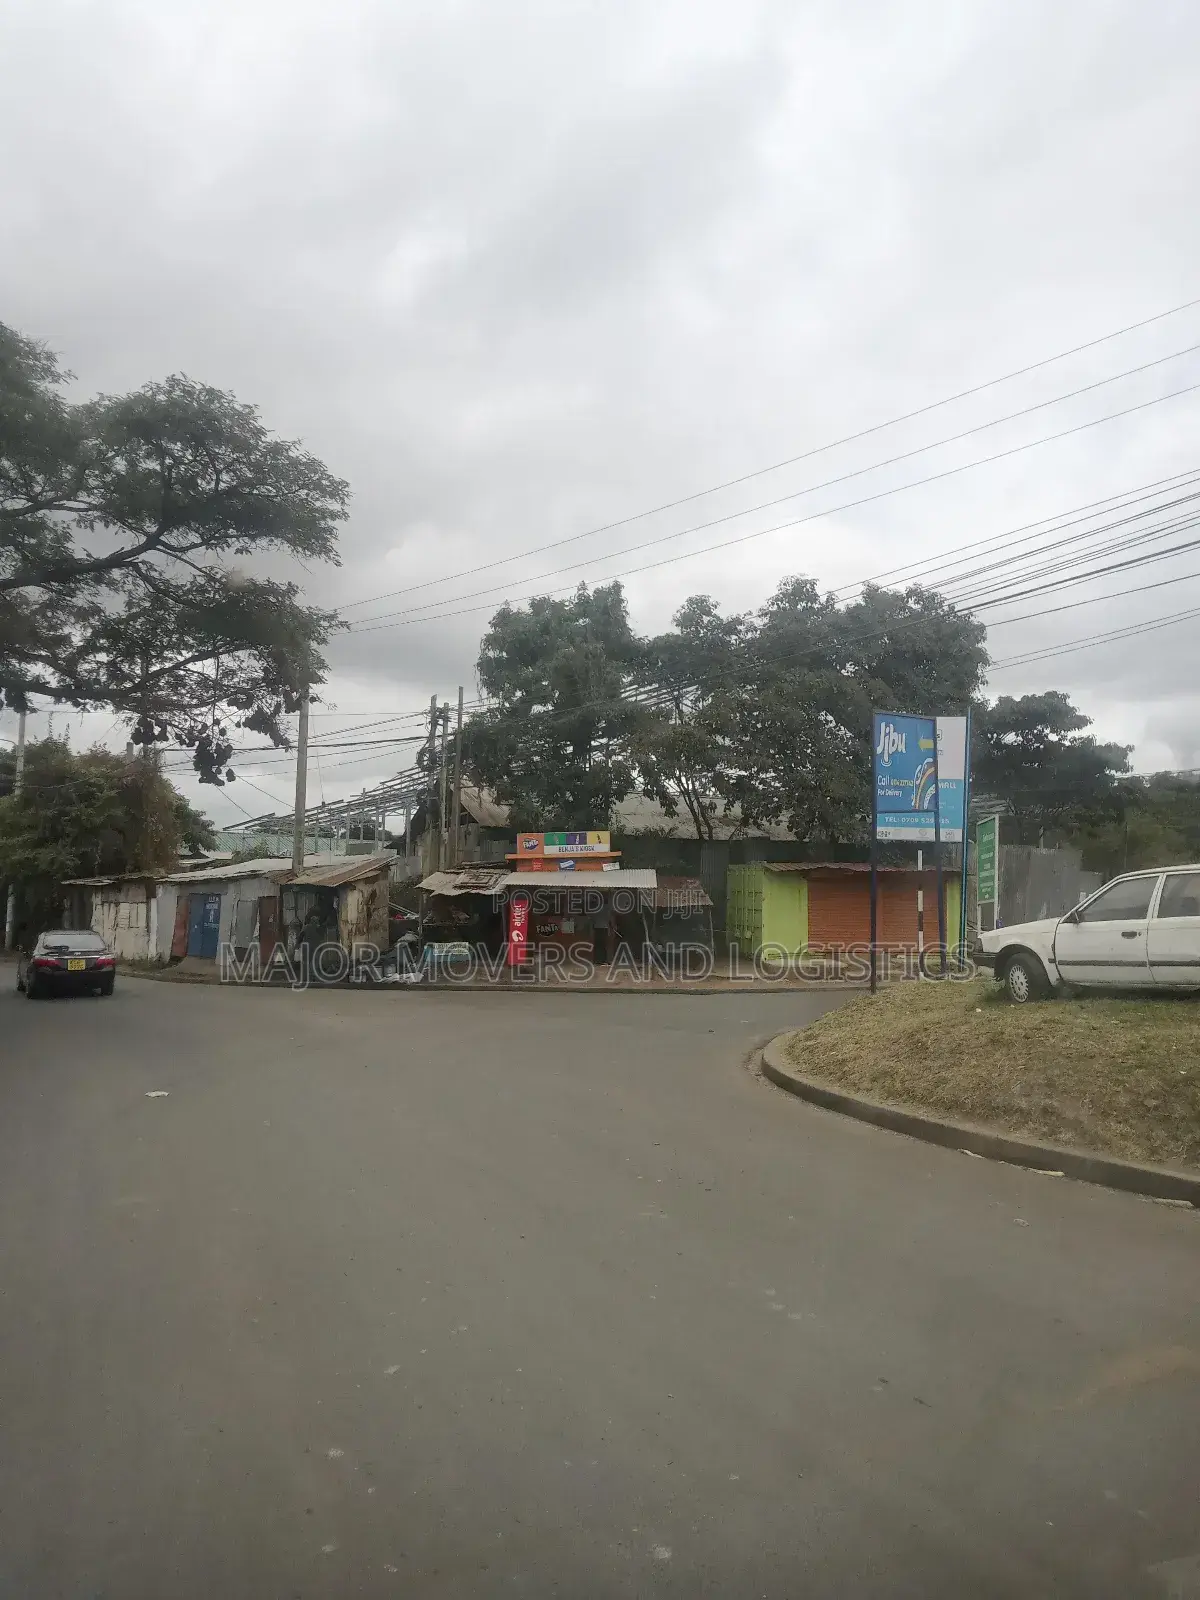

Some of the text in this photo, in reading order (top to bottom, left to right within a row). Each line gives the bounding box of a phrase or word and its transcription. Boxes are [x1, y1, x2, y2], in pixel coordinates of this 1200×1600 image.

[877, 721, 906, 763] Jibu
[877, 775, 890, 786] Call
[512, 904, 522, 927] airtel
